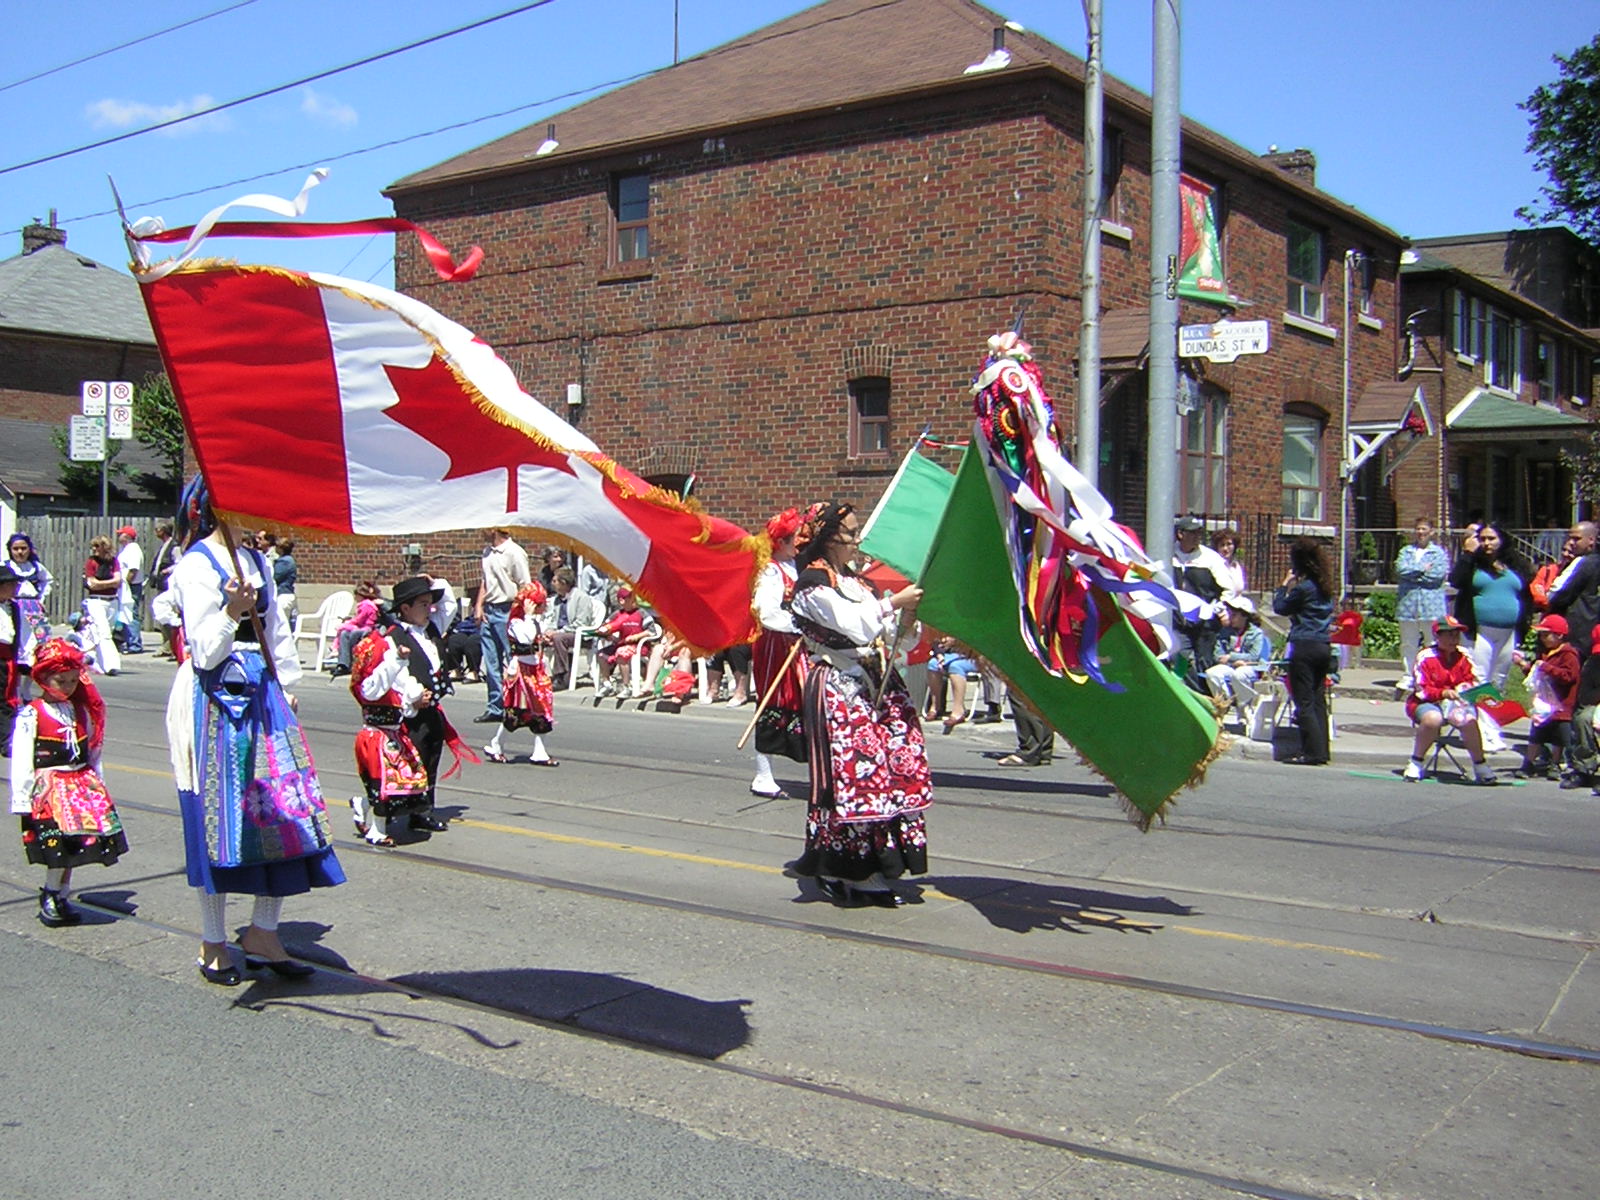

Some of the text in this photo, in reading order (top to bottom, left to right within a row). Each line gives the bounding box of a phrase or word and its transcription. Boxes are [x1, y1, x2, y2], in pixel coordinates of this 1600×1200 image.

[1185, 338, 1261, 354] DUNDAS ST W
